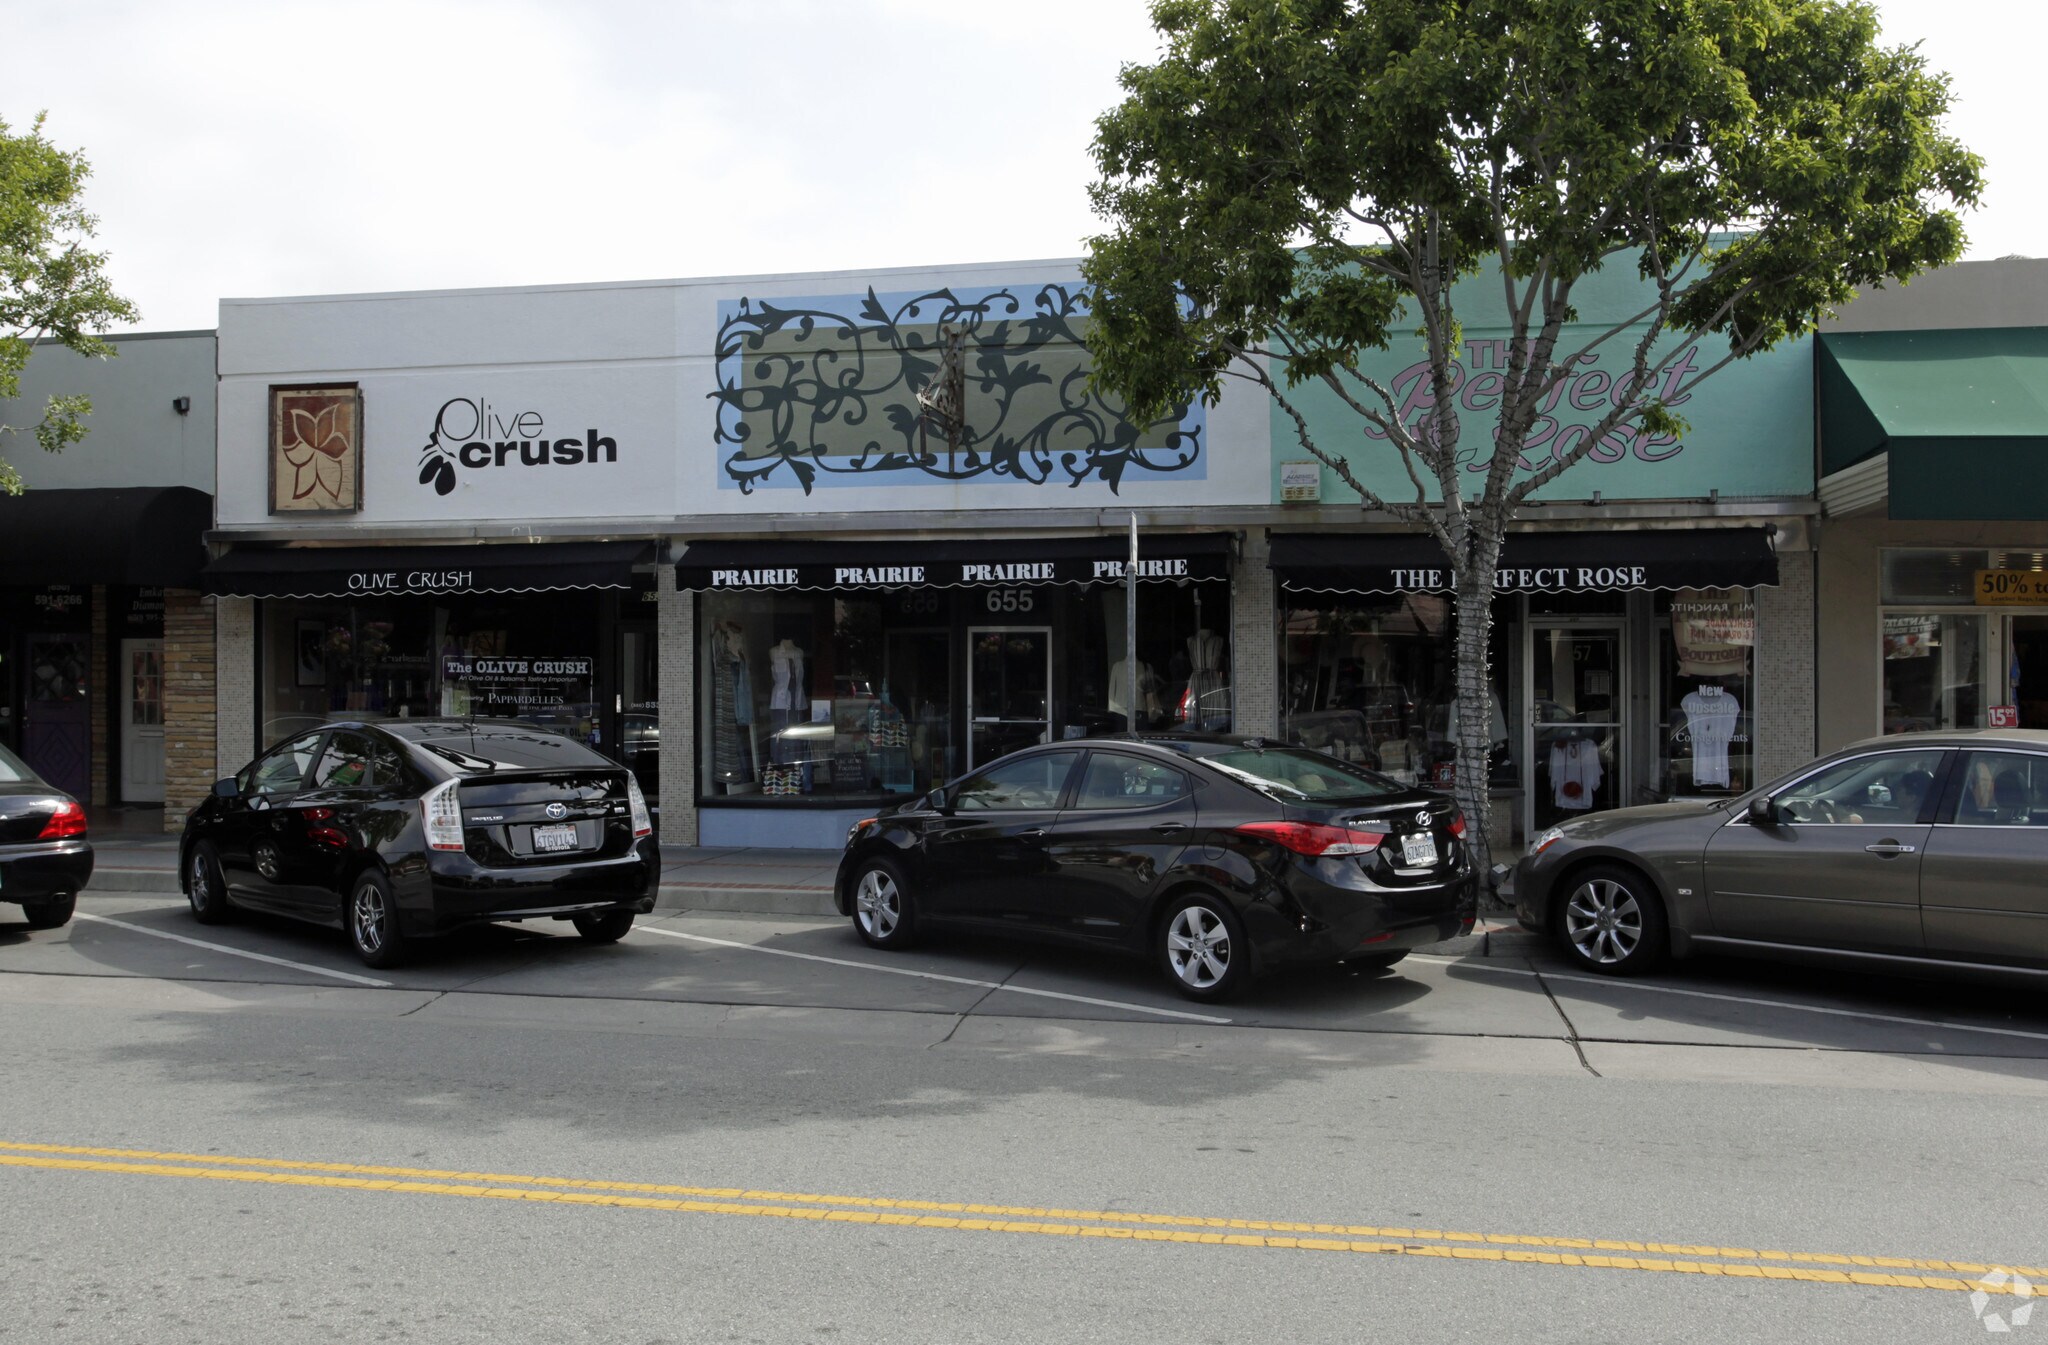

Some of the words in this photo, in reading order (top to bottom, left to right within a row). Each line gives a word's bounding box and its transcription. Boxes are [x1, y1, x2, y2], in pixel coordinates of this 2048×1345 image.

[1365, 345, 1700, 440] Pefect
[438, 397, 544, 442] Olive
[458, 428, 617, 469] crush
[347, 573, 400, 589] OLIVE
[407, 570, 472, 588] CRUSH
[711, 568, 800, 587] PRAIRIE
[834, 565, 925, 585] PRAIRIE
[961, 562, 1055, 582] PRAIRIE
[1390, 569, 1443, 588] THE
[1451, 567, 1569, 589] FECT
[1576, 566, 1648, 586] ROSE
[1982, 574, 2028, 593] 50%
[643, 592, 658, 601] 65
[986, 589, 1034, 612] 655
[1567, 644, 1592, 661] 57
[447, 662, 472, 673] The
[476, 661, 529, 674] OLIVE
[533, 661, 588, 674] CRUSH
[1698, 684, 1724, 697] New
[1688, 702, 1735, 715] Upscale
[1348, 819, 1381, 827] ELANTRA
